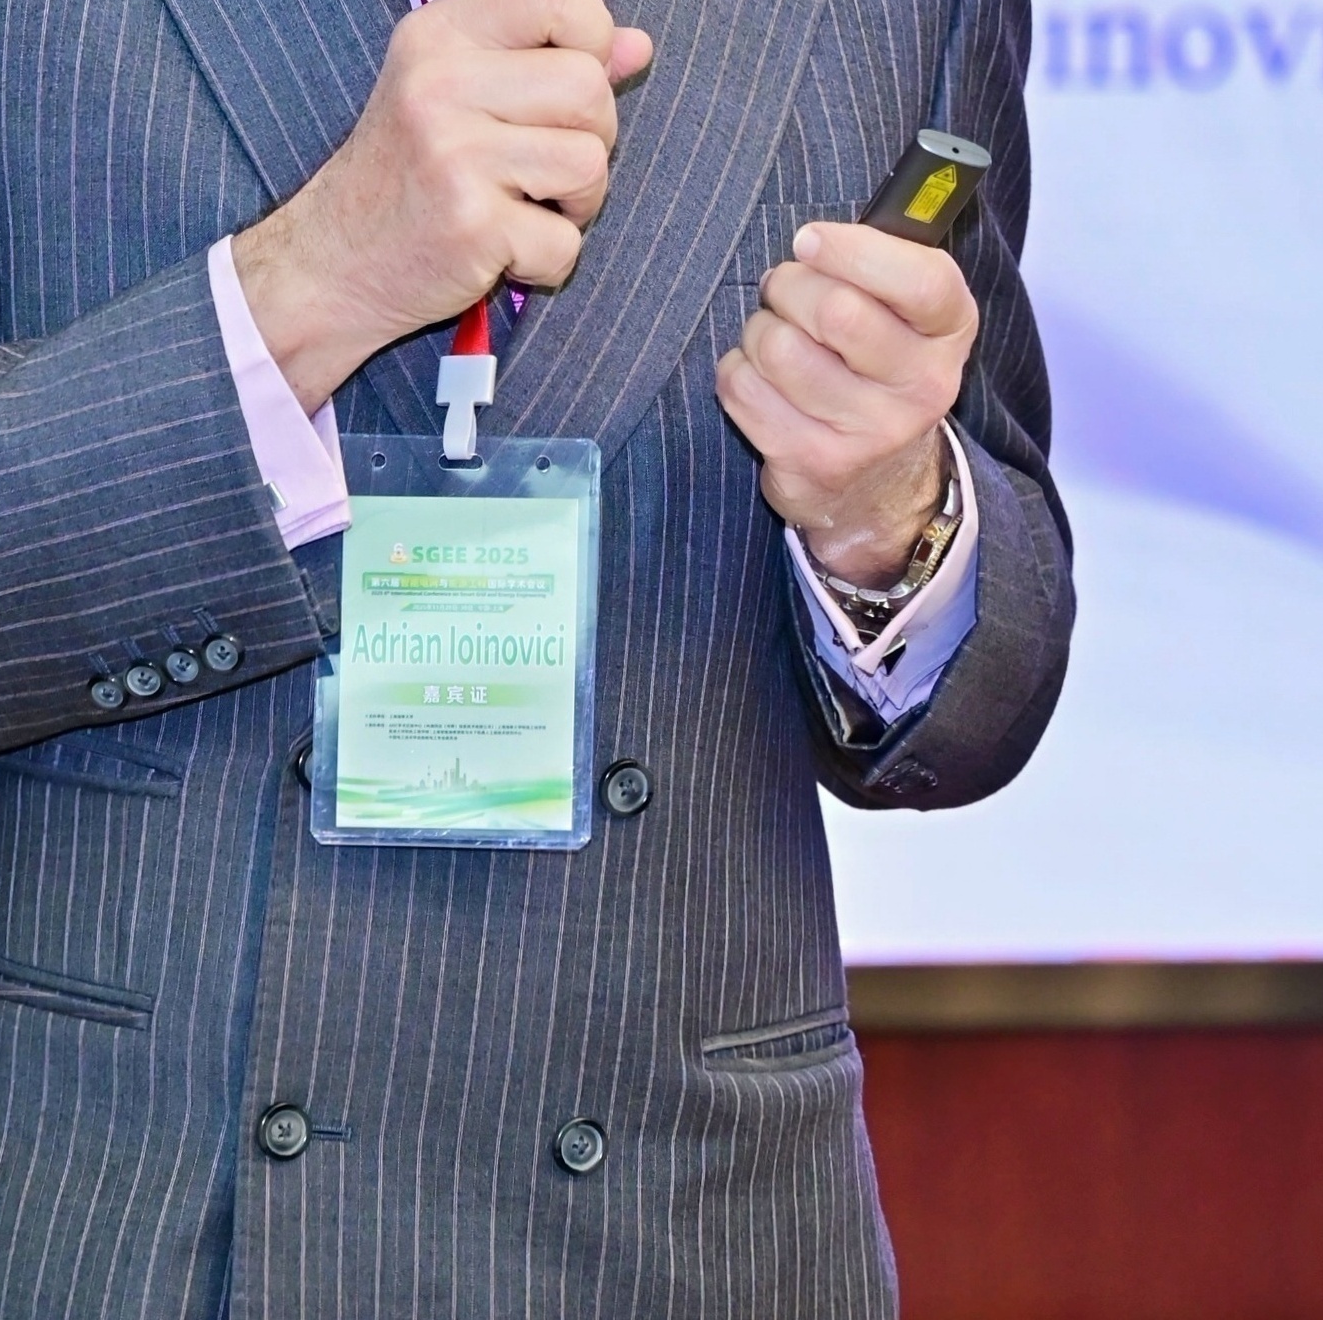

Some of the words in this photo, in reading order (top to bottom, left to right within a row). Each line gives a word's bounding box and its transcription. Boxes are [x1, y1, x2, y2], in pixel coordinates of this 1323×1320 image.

[412, 546, 467, 563] SGEE
[474, 547, 529, 565] 2025
[351, 621, 442, 665] Adrian
[450, 622, 565, 666] Ioinovici
